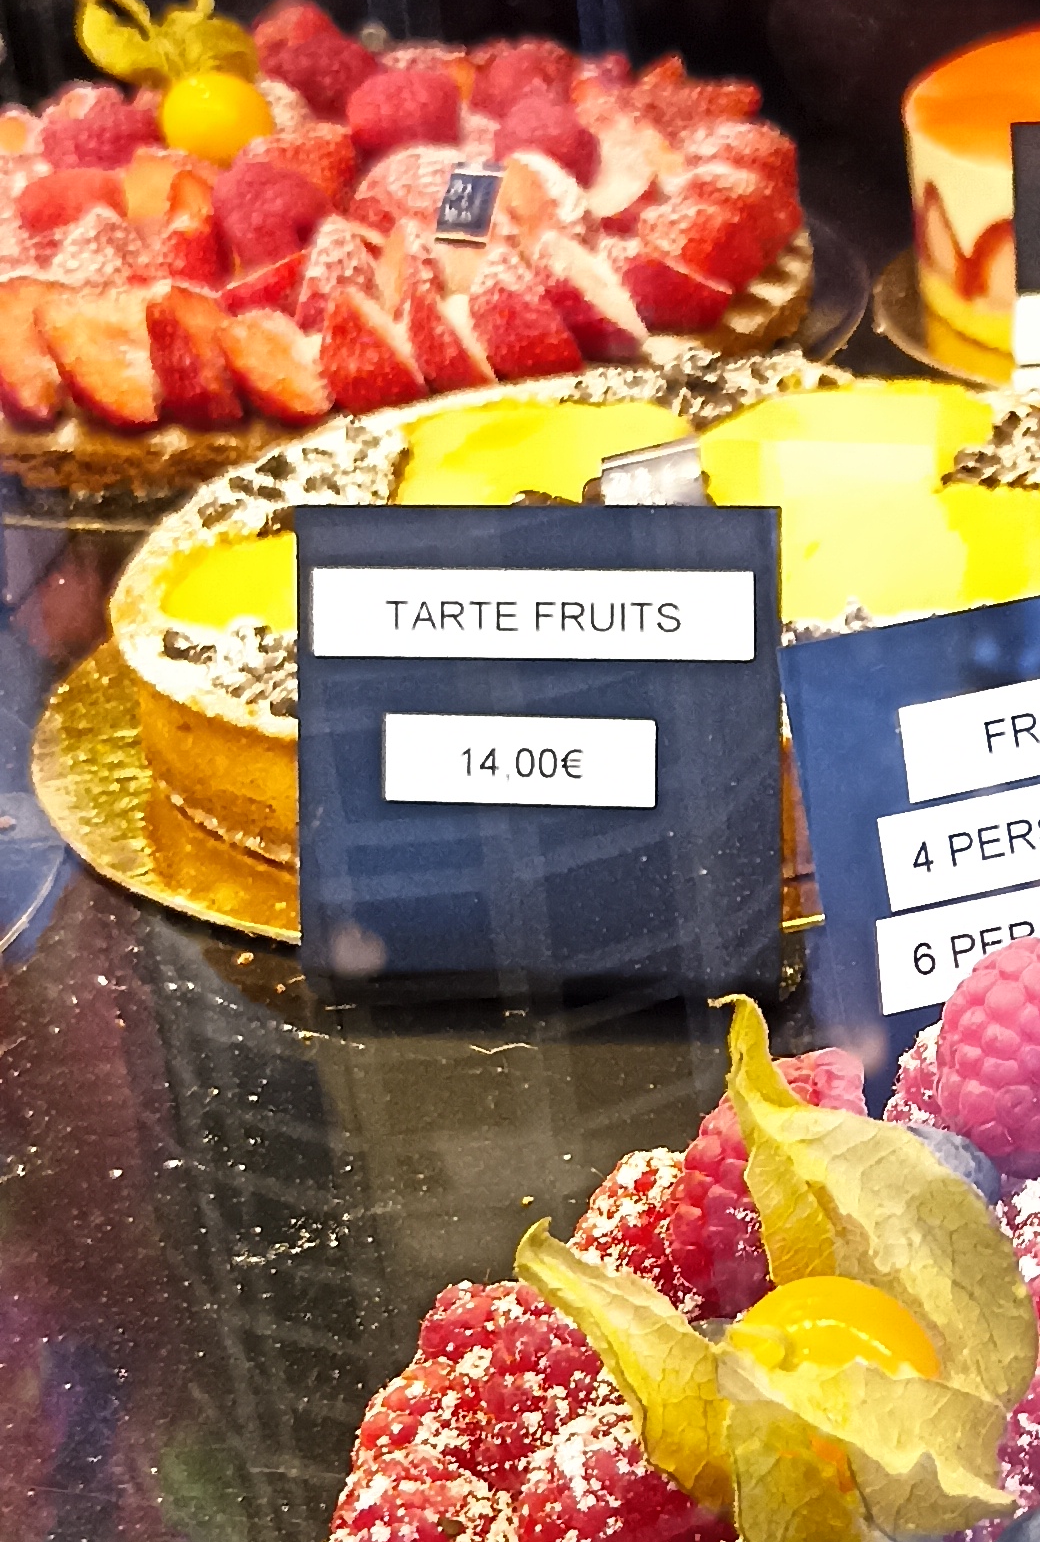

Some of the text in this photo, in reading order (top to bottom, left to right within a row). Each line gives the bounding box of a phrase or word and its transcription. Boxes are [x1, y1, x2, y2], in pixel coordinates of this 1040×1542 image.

[385, 600, 682, 634] TARTE FRUITS
[911, 840, 935, 874] 4
[913, 941, 936, 976] 6
